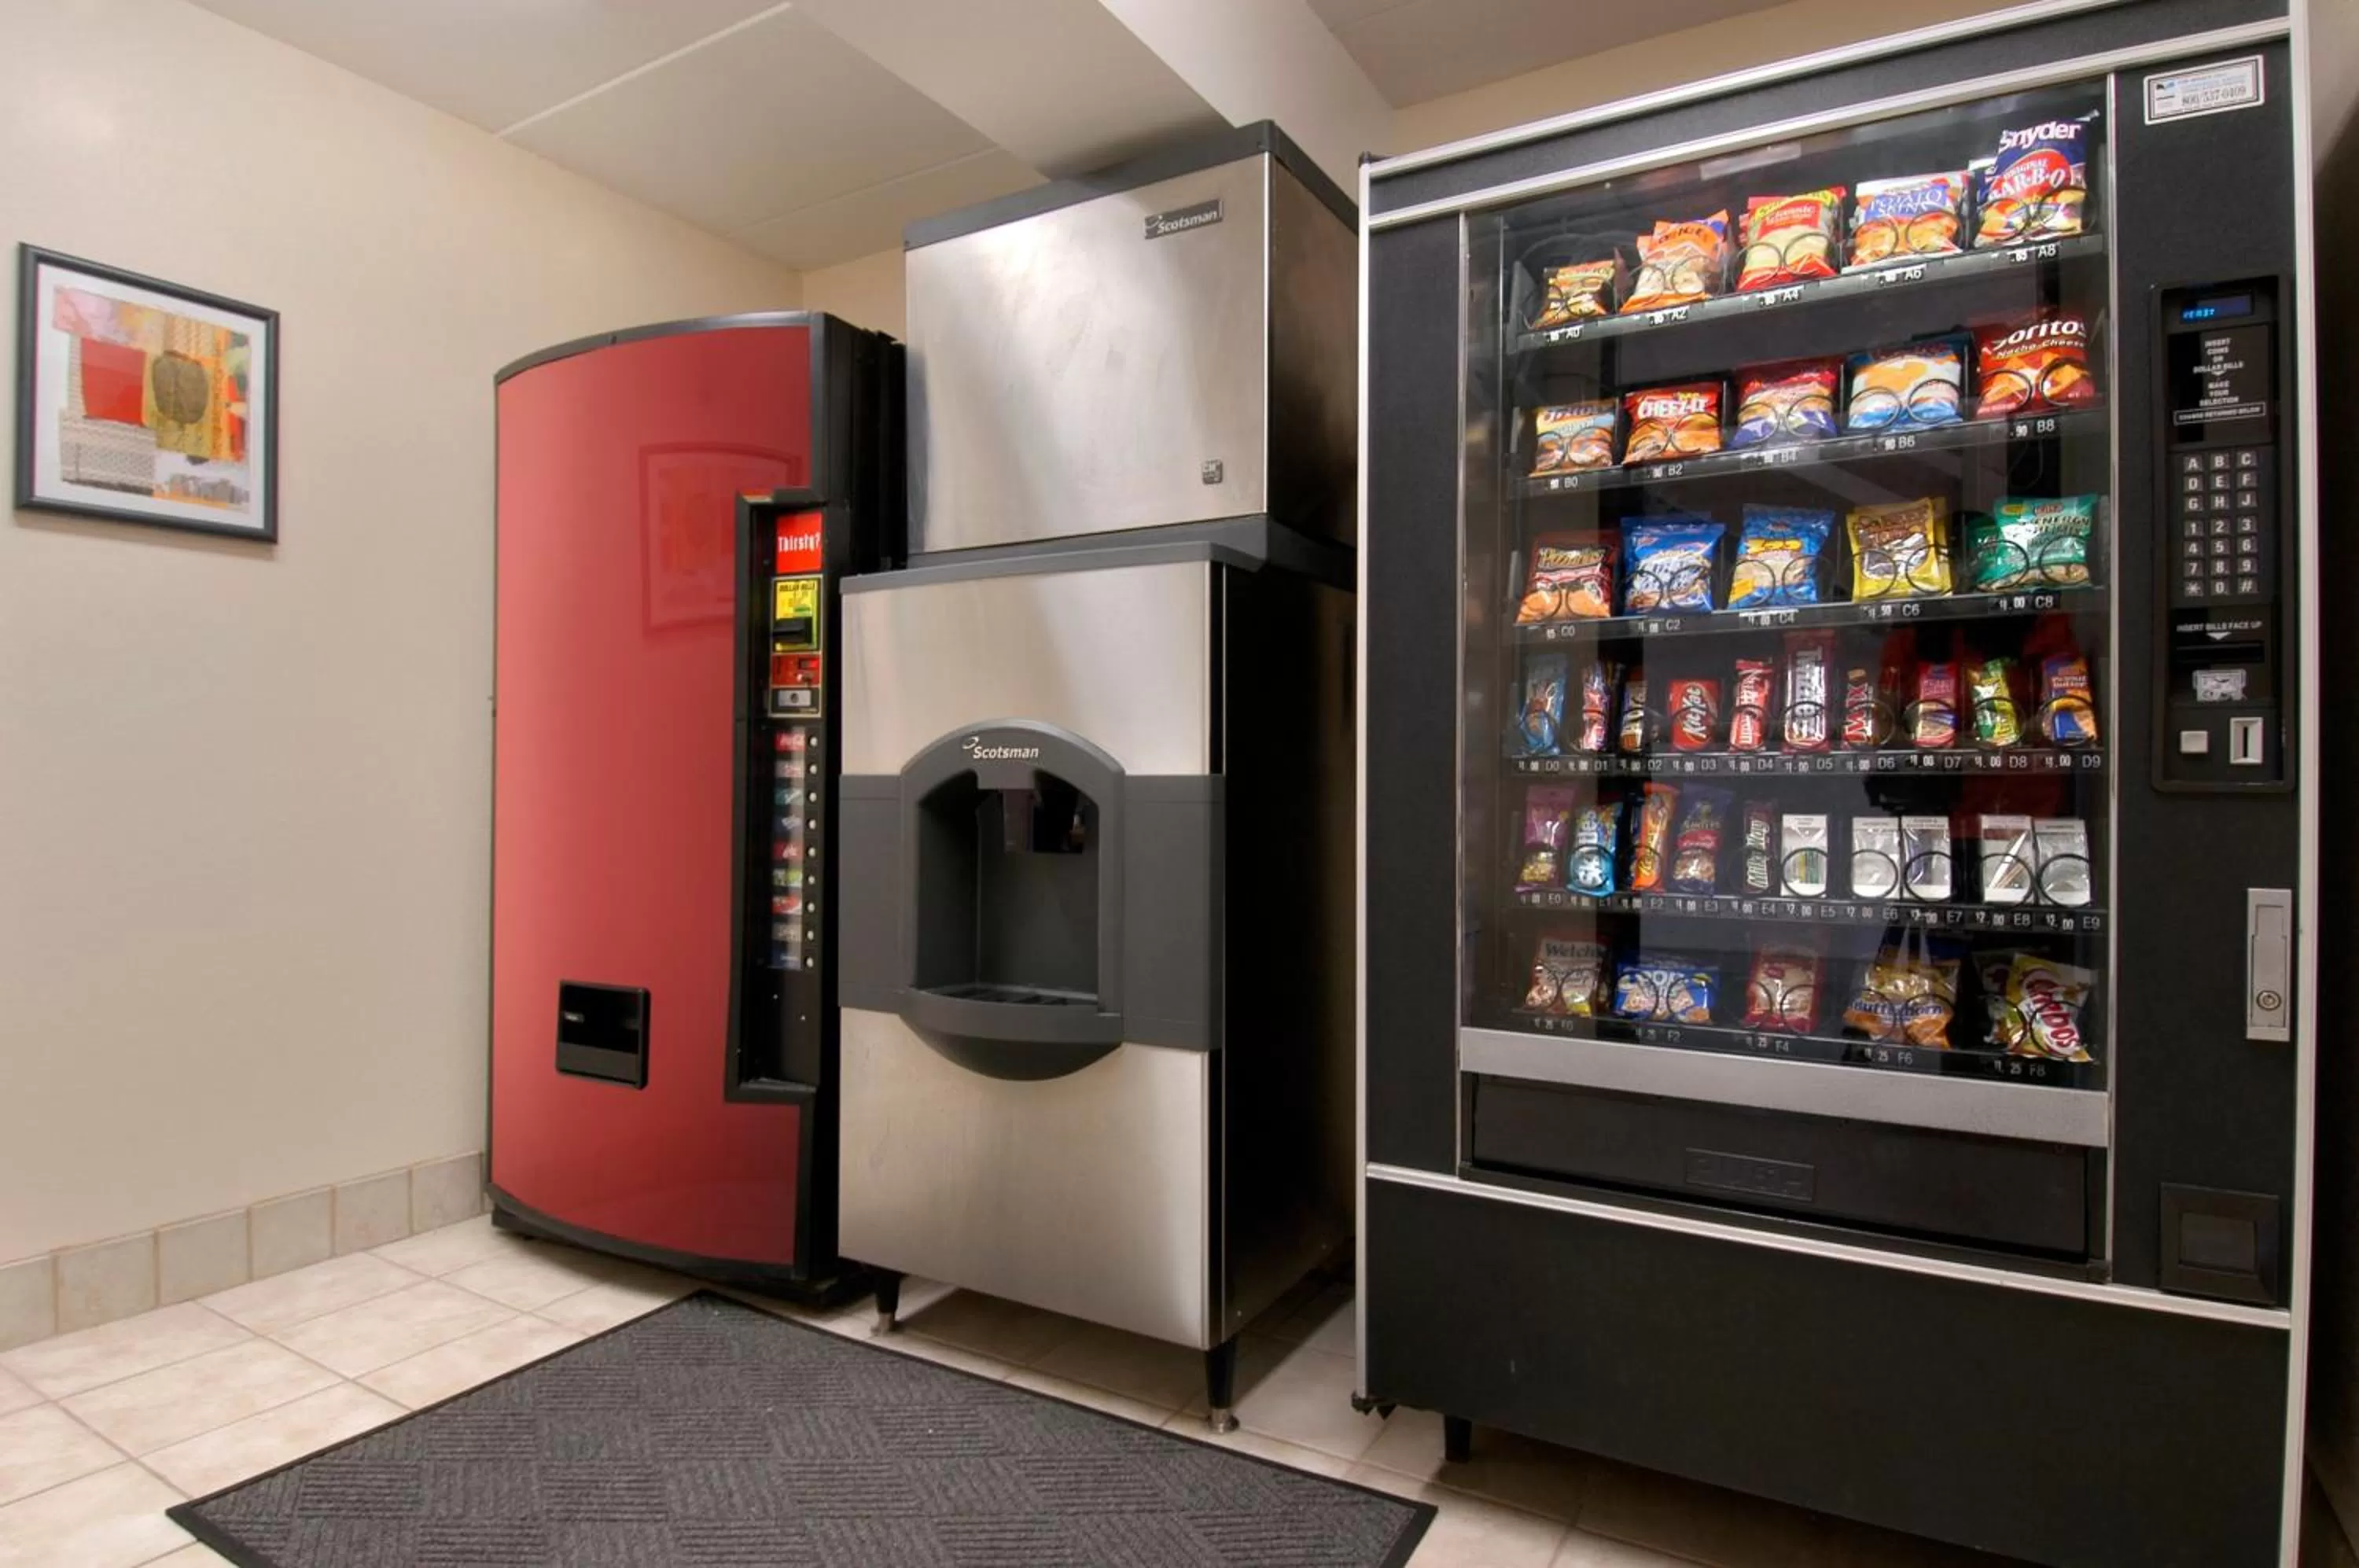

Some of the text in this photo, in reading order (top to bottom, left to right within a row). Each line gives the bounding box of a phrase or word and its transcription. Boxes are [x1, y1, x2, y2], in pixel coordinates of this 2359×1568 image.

[1157, 210, 1218, 234] Scotsman
[2037, 245, 2056, 258] A8
[2199, 396, 2239, 407] SELECTION
[2037, 418, 2055, 432] B8
[1668, 464, 1683, 476] B2
[2035, 594, 2053, 609] C8
[1903, 603, 1920, 617] C6
[1561, 625, 1575, 636] C0
[1665, 619, 1680, 630] C2
[2206, 621, 2227, 631] BILLS
[973, 745, 1039, 759] Scotsman
[1757, 758, 1773, 769] D4
[1816, 757, 1833, 770] D5
[1877, 756, 1895, 769] D6
[1944, 756, 1962, 768] D7
[2009, 756, 2027, 767] D8
[2082, 756, 2101, 767] D9
[1761, 903, 1776, 915] E4
[1820, 906, 1836, 918] E5
[1946, 910, 1963, 922] E7
[2014, 913, 2031, 926] E8
[2083, 916, 2100, 929] E9
[1667, 1029, 1680, 1043] F2
[1775, 1040, 1790, 1052] F4
[1897, 1051, 1913, 1065] F6
[2030, 1064, 2046, 1077] F8
